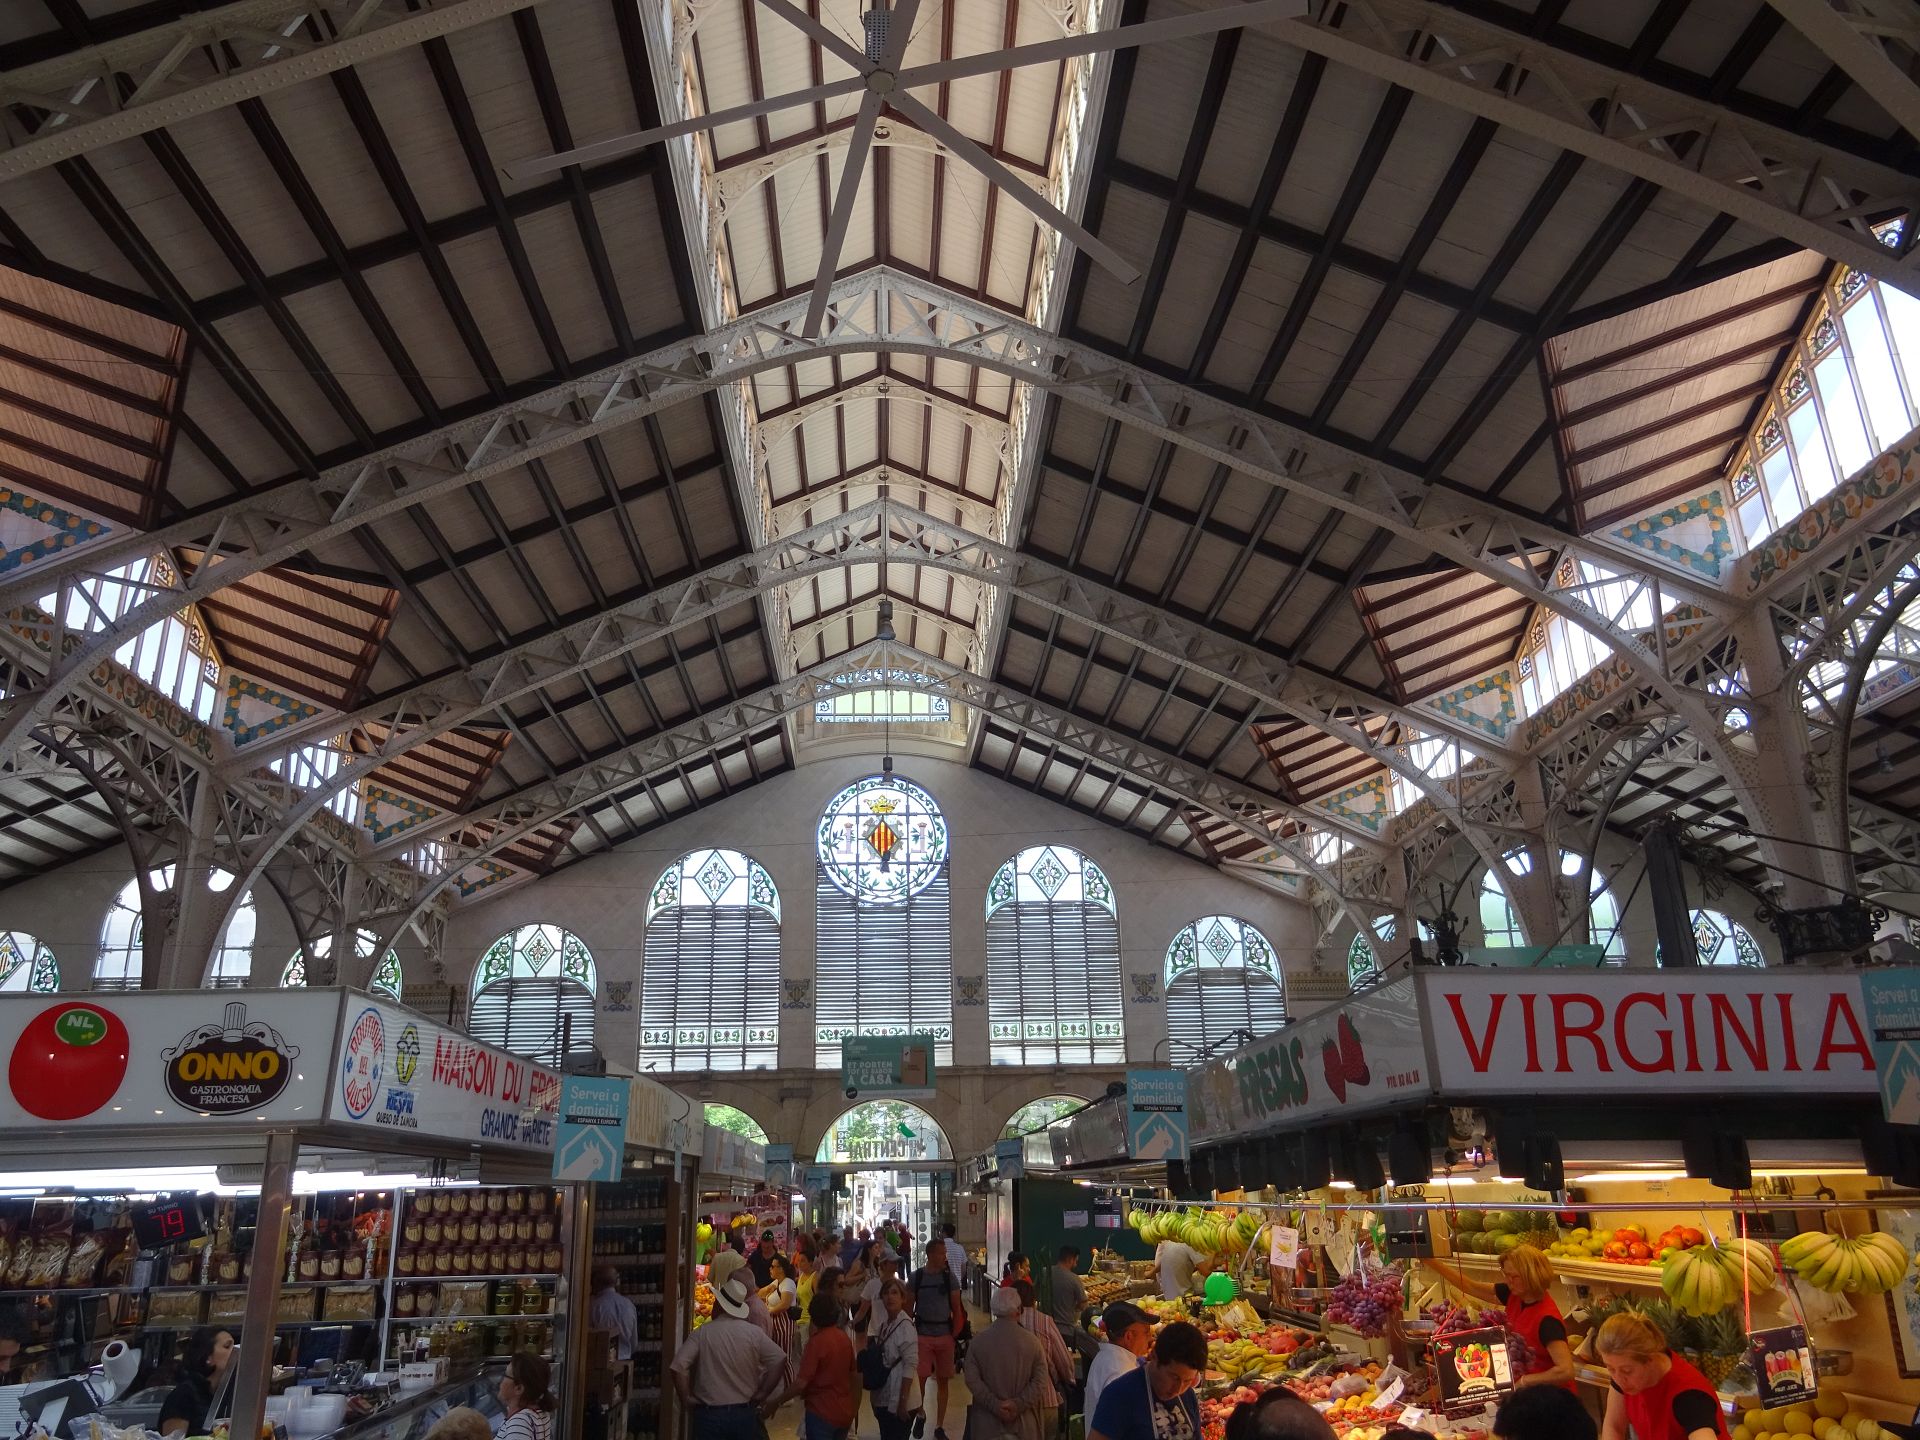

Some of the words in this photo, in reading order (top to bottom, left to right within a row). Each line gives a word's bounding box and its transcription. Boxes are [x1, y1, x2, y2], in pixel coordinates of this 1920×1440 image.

[1871, 984, 1907, 1005] Servei
[66, 1014, 94, 1029] NL
[350, 1015, 383, 1056] BOUTIQUE
[1443, 992, 1876, 1074] VIRGINIA
[178, 1050, 280, 1081] ONNO
[359, 1055, 369, 1075] DEL
[432, 1034, 498, 1097] MAISON
[502, 1061, 524, 1104] DU
[847, 1061, 857, 1069] ET
[860, 1060, 892, 1069] PORTEM
[847, 1075, 855, 1085] A
[860, 1074, 892, 1085] CASA
[1131, 1078, 1174, 1090] Servicio
[1177, 1082, 1183, 1090] a
[190, 1085, 262, 1095] GASTRONOMIA
[346, 1078, 373, 1111] QUESO
[570, 1085, 610, 1101] Servei
[612, 1093, 620, 1101] a
[1133, 1091, 1183, 1104] domicilio
[199, 1094, 250, 1104] FRANCESA
[569, 1102, 618, 1116] domicili
[376, 1111, 393, 1125] QUESO
[393, 1114, 400, 1125] DE
[400, 1115, 418, 1128] ZAMORA
[481, 1107, 519, 1140] GRANDE
[157, 1202, 178, 1211] TURNO
